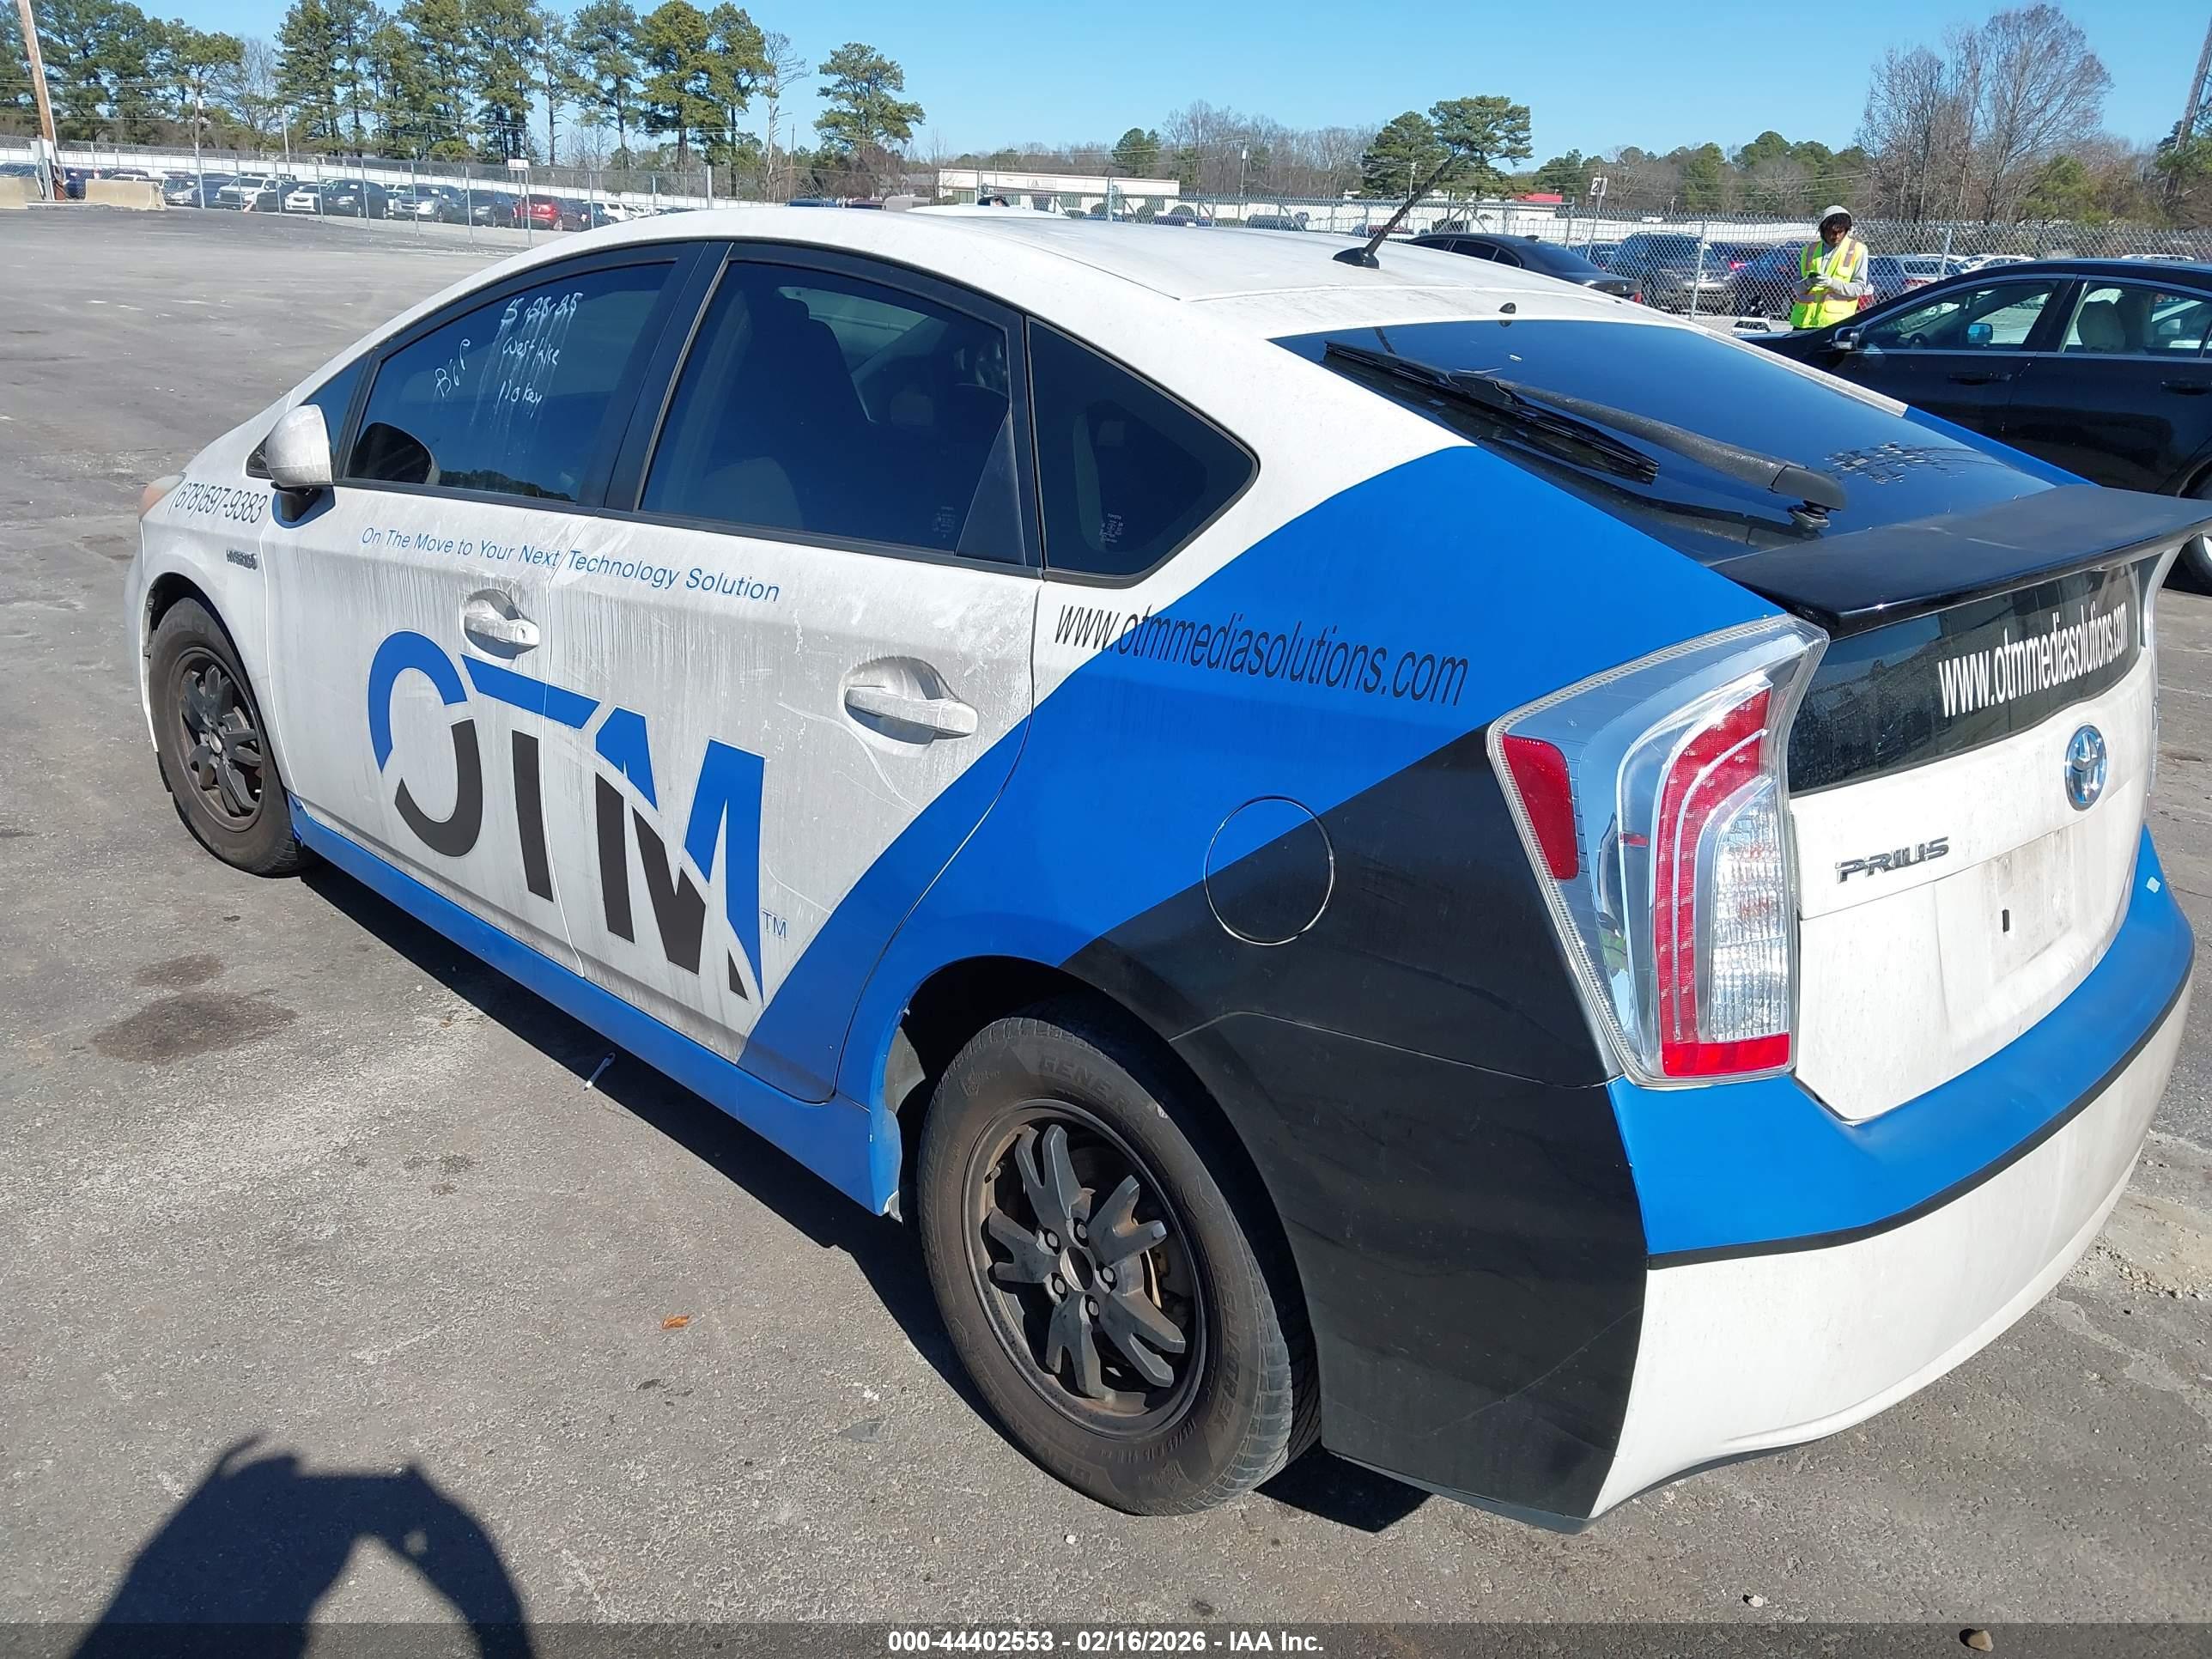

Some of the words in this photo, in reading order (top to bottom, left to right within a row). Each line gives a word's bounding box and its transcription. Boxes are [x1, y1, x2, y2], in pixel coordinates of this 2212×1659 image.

[167, 482, 268, 524] (678)597-9383
[362, 527, 381, 544] On
[386, 530, 410, 548] The
[413, 533, 453, 553] Move
[458, 539, 473, 556] to
[479, 540, 515, 561] Your
[518, 545, 561, 567] Next
[568, 550, 680, 590] Technology
[686, 568, 780, 602] Solution
[1054, 604, 1469, 707] www.otmmediasolutions.com
[1938, 600, 2128, 718] www.otmmediasolutions.com
[368, 629, 767, 1006] OTM
[1836, 836, 1949, 884] PRIUS
[762, 908, 787, 939] TM
